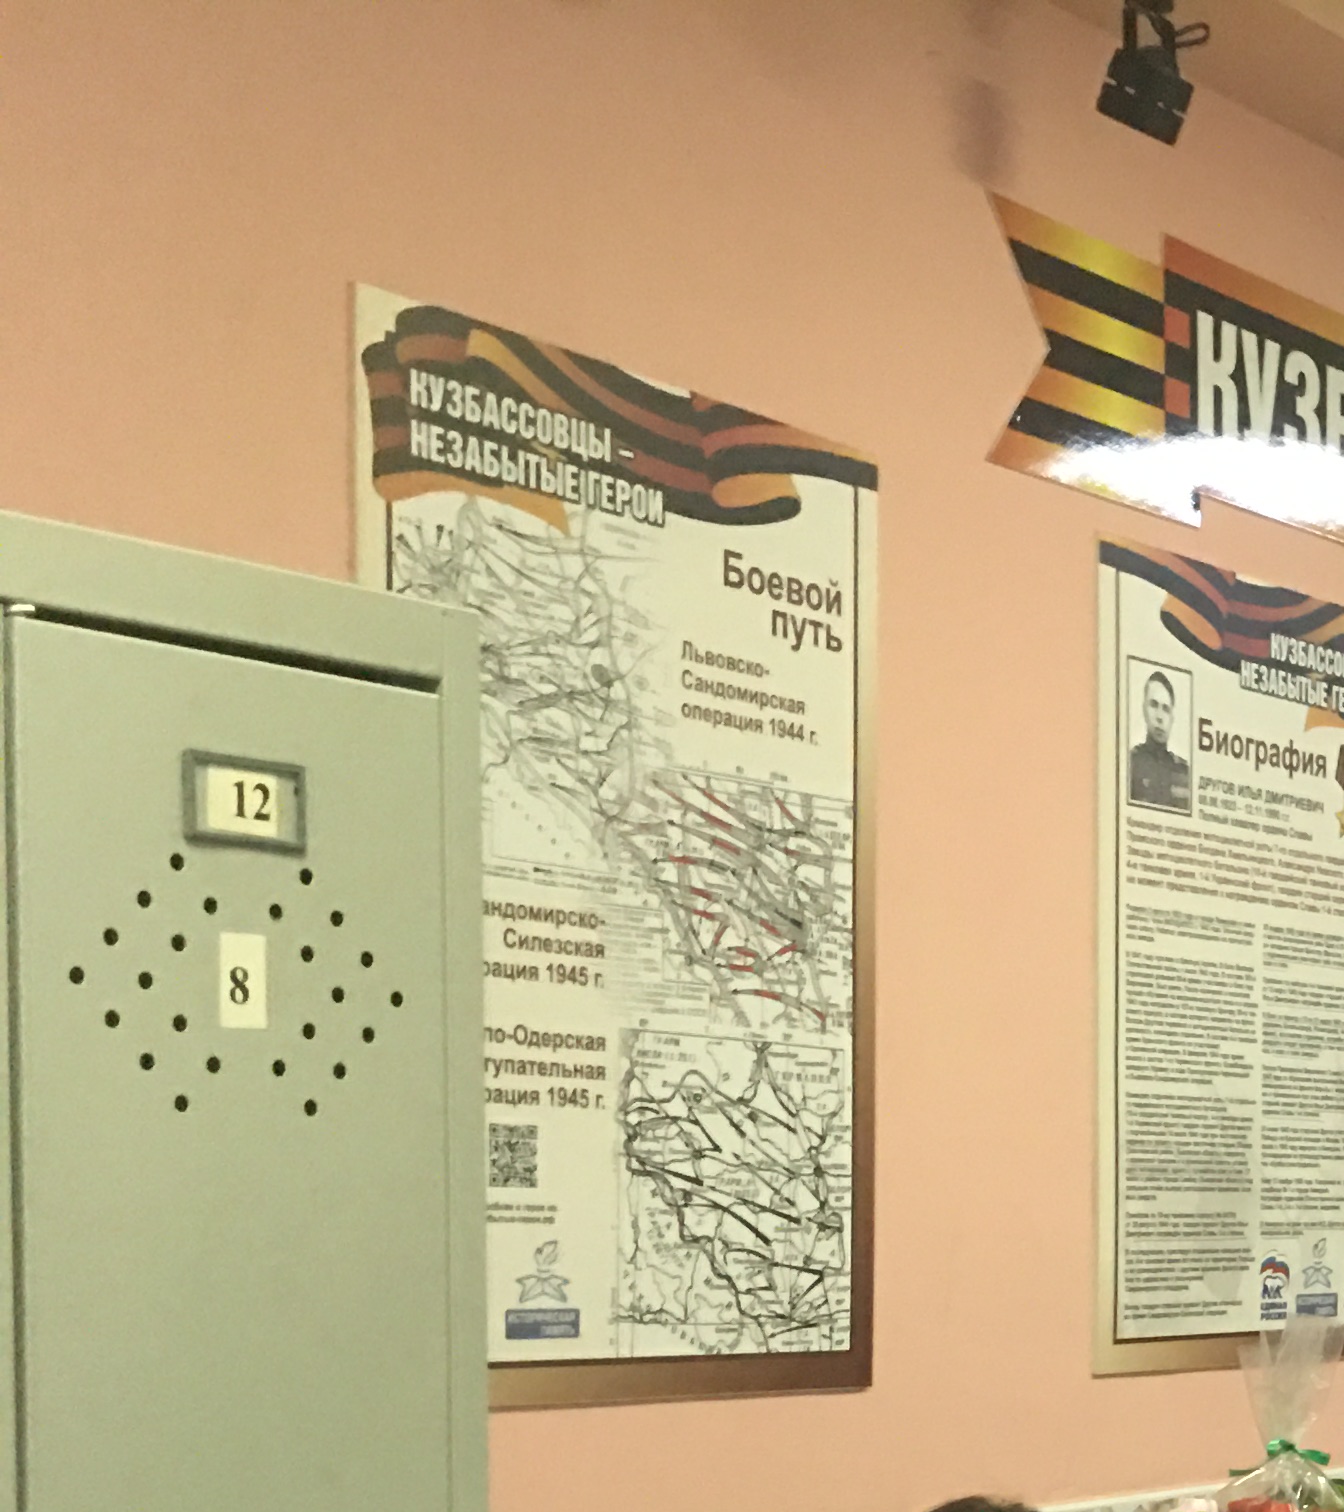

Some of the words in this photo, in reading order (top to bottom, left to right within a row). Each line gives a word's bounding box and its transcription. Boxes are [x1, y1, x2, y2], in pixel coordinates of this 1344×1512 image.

[410, 368, 611, 460] КУЗБАССОВЦЫ
[411, 419, 580, 498] НЕЗАБЫТЫЕ
[586, 478, 665, 527] ГЕРОИ
[723, 550, 842, 616] Боевой
[772, 609, 842, 653] путь
[682, 642, 770, 679] Львовско-
[682, 670, 805, 716] Сандомирская
[1241, 660, 1328, 708] НЕЗАБЫТЫЕ
[682, 702, 763, 734] операция
[768, 717, 804, 743] 1944
[1198, 717, 1326, 779] Биография
[233, 781, 271, 821] 12
[482, 899, 605, 929] андомирско-
[503, 928, 605, 958] Силезская
[230, 966, 249, 1005] 8
[546, 963, 588, 987] 1945
[484, 1024, 606, 1053] ло-Одерская
[484, 1056, 606, 1081] тупательная
[548, 1087, 589, 1109] 1945
